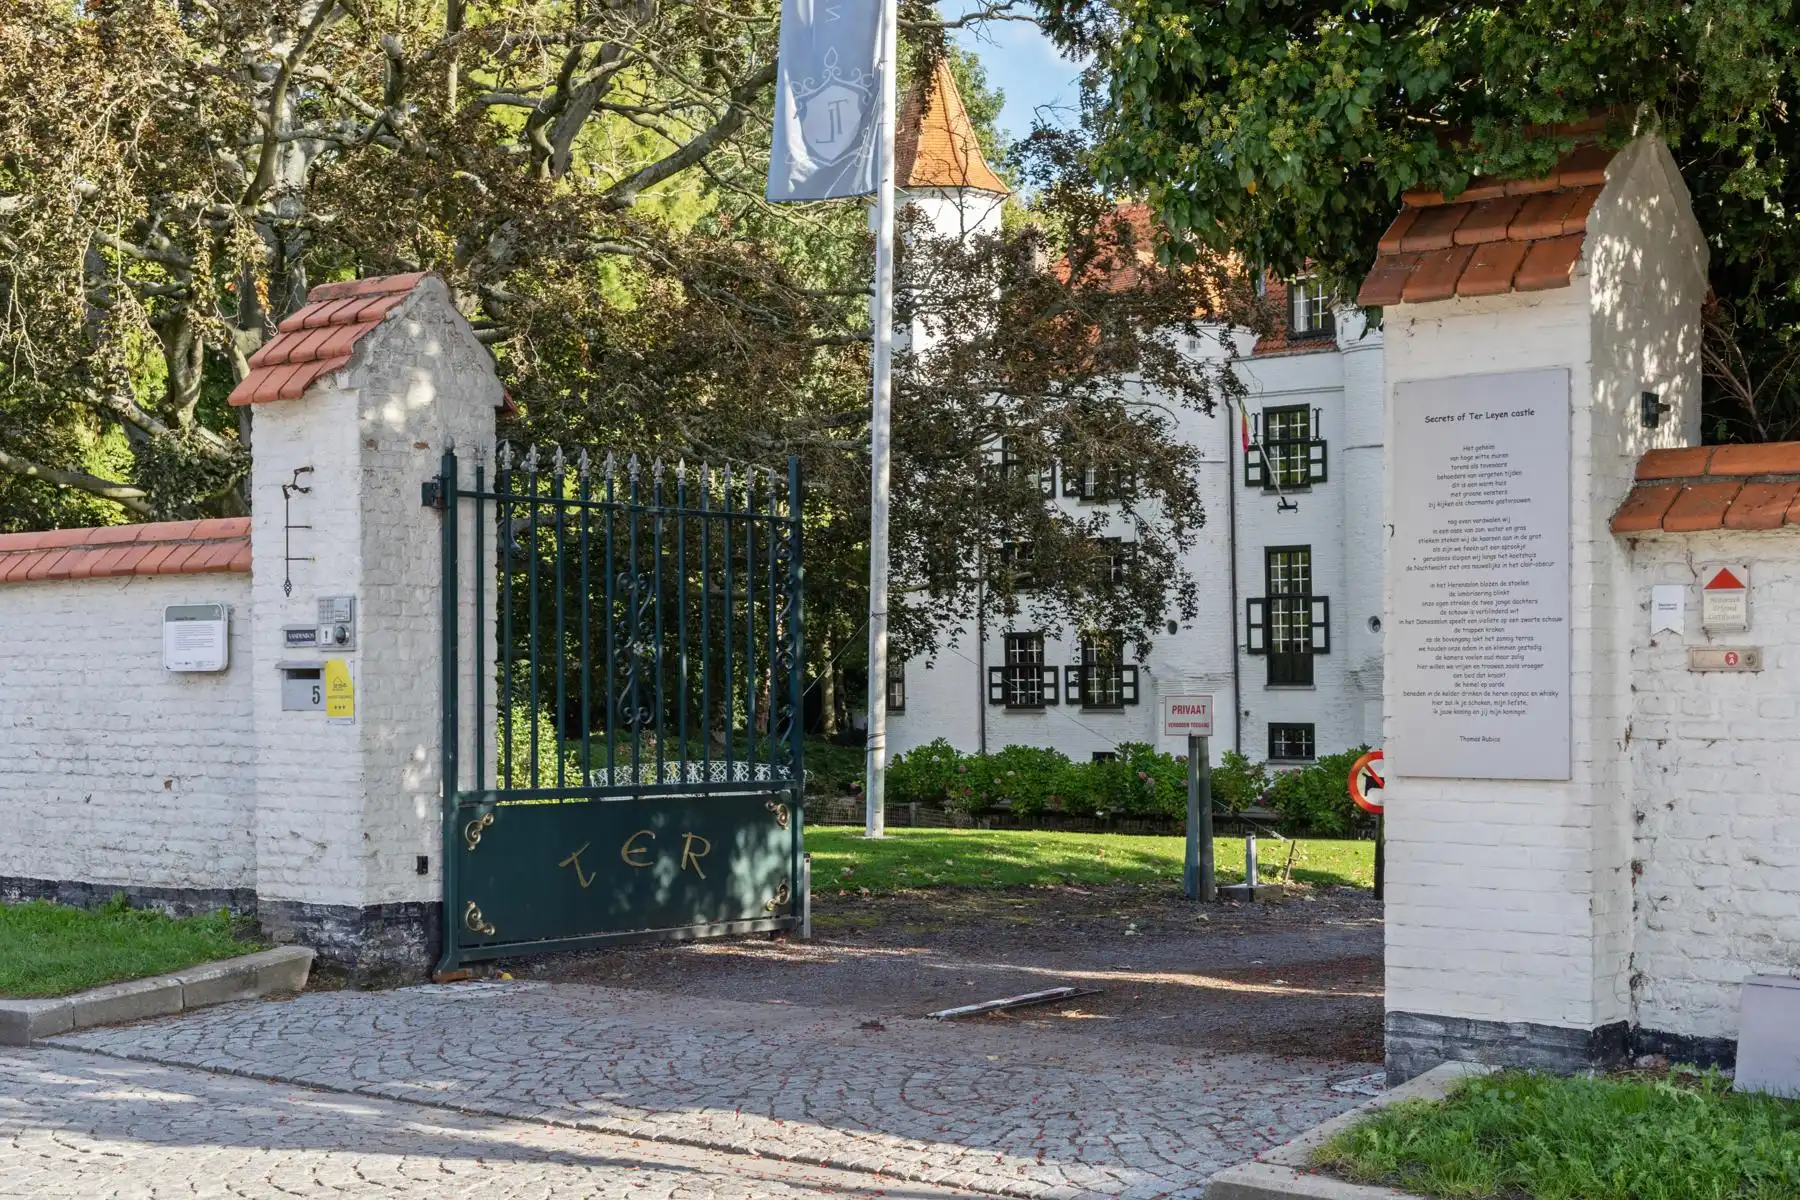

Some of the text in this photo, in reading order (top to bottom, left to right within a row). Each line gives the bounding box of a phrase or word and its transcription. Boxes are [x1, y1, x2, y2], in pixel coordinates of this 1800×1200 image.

[1424, 408, 1535, 423] Secrets of Ter Leyen castle
[312, 685, 321, 704] 5
[1171, 705, 1206, 715] PRIVAAT
[558, 830, 711, 888] TER
